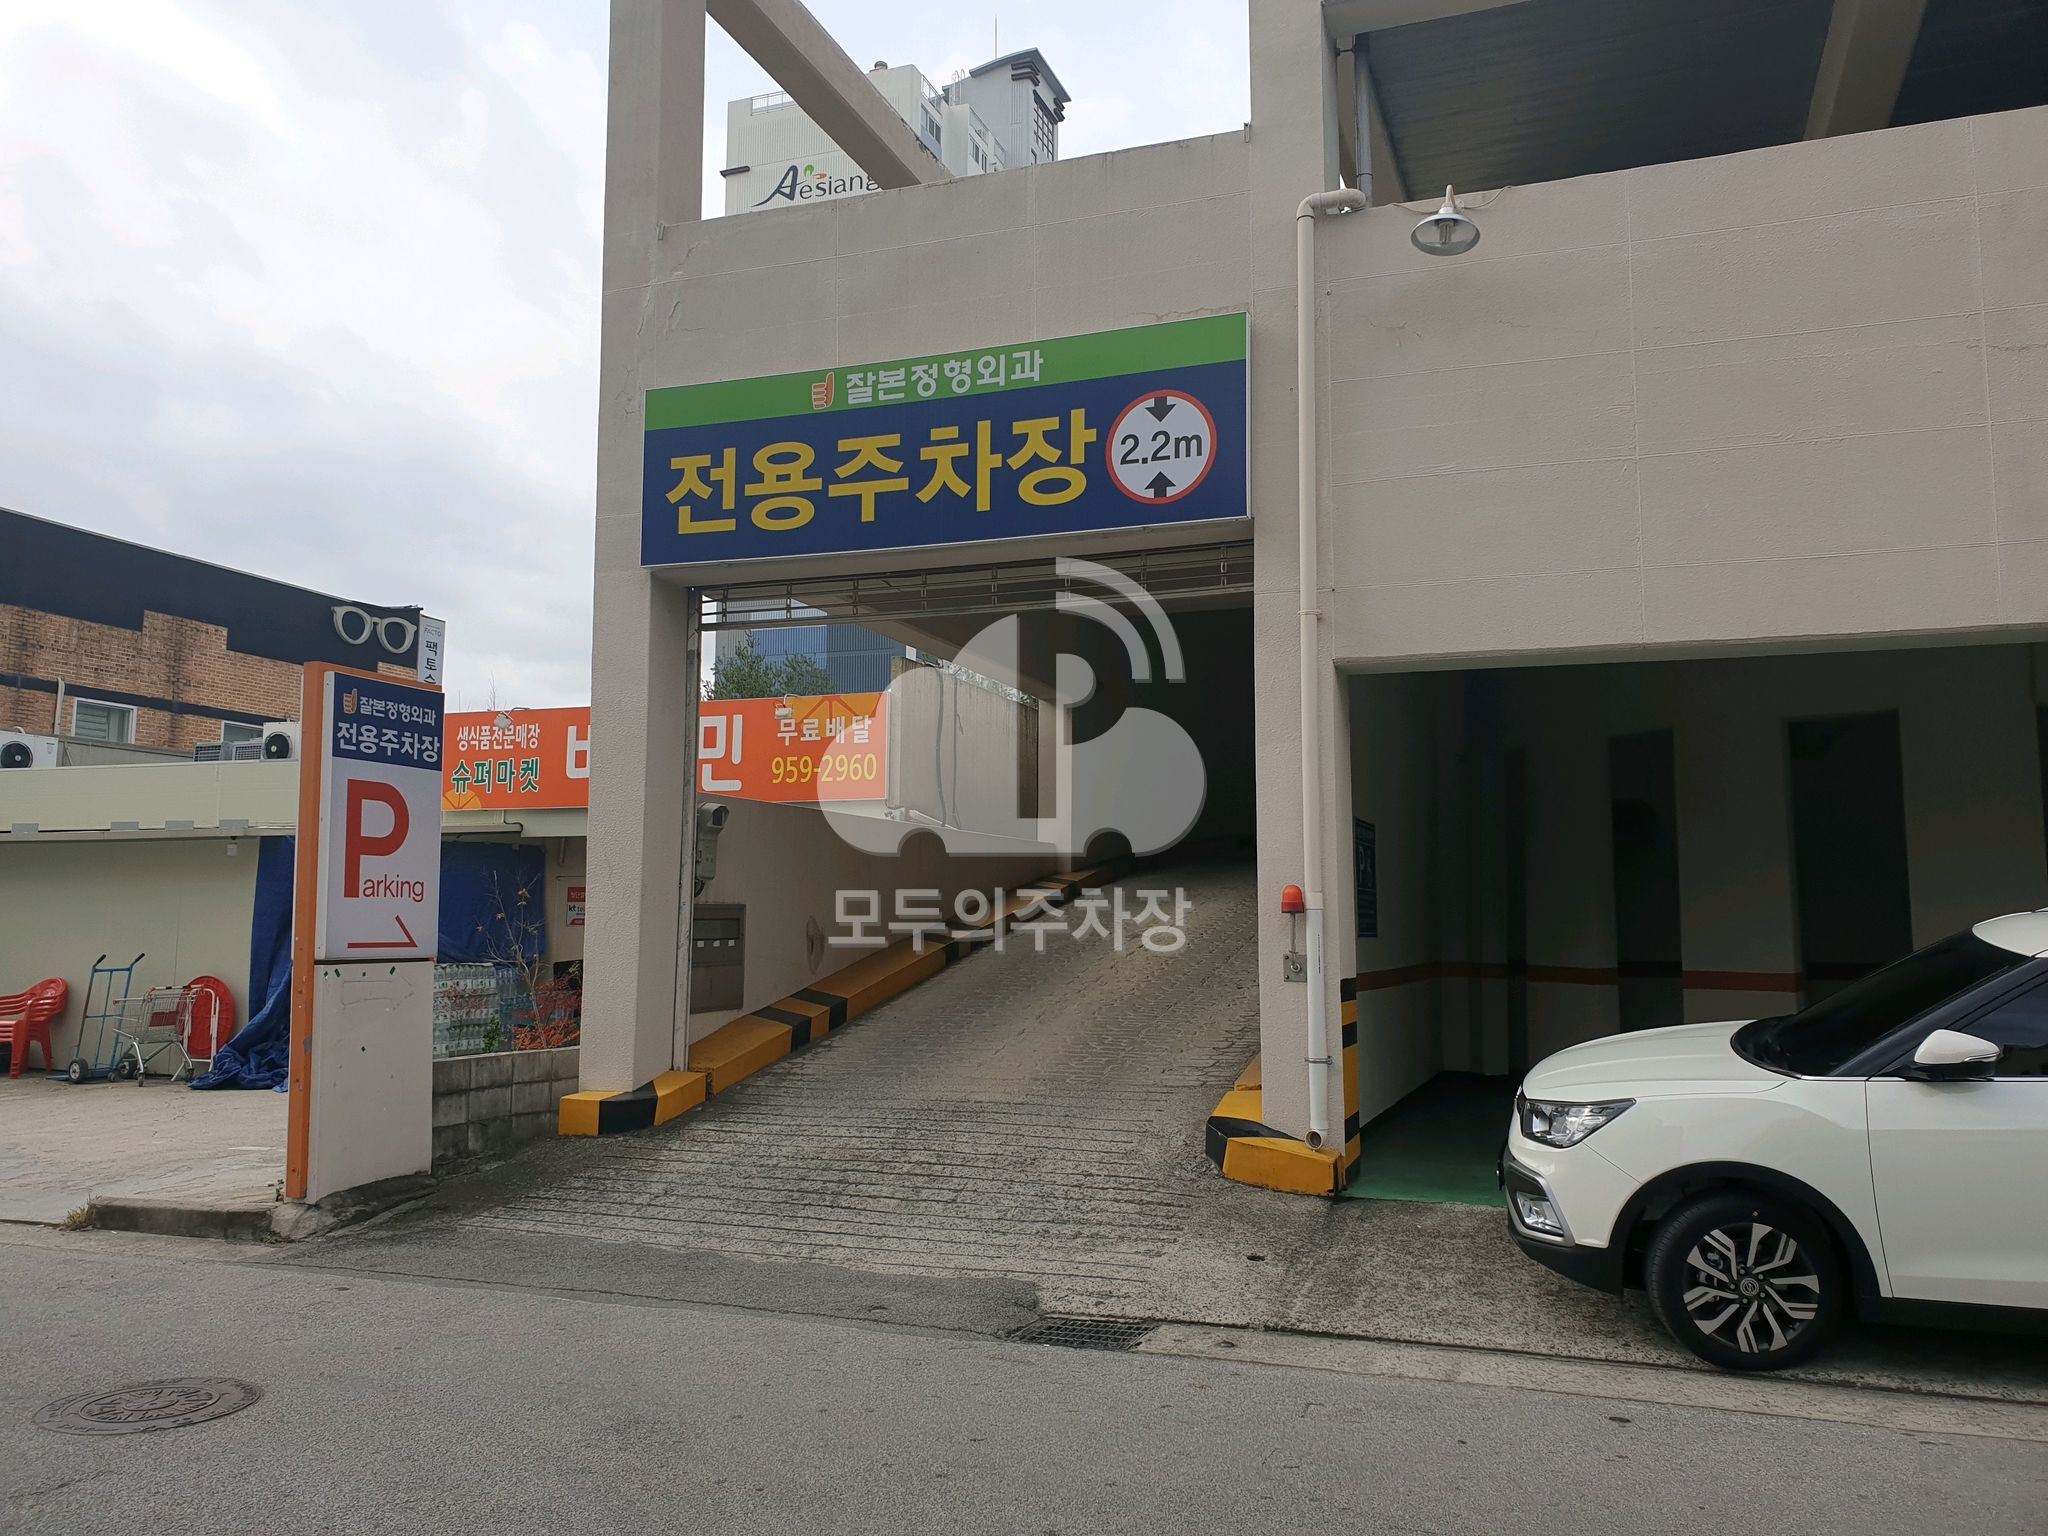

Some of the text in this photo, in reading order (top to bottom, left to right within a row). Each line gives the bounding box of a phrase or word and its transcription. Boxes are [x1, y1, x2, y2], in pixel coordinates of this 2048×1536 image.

[846, 350, 1044, 405] 잘본정형외과
[1120, 431, 1203, 467] 2.2m
[665, 408, 1097, 535] 전용주차장
[359, 696, 436, 726] 잘본정형외과
[336, 722, 440, 763] 전용주차장
[456, 723, 540, 751] 생식품전문매장
[777, 714, 872, 746] 무료배달
[451, 756, 540, 795] 슈퍼마켓
[771, 753, 877, 784] 959-2960
[343, 778, 424, 903] Parking
